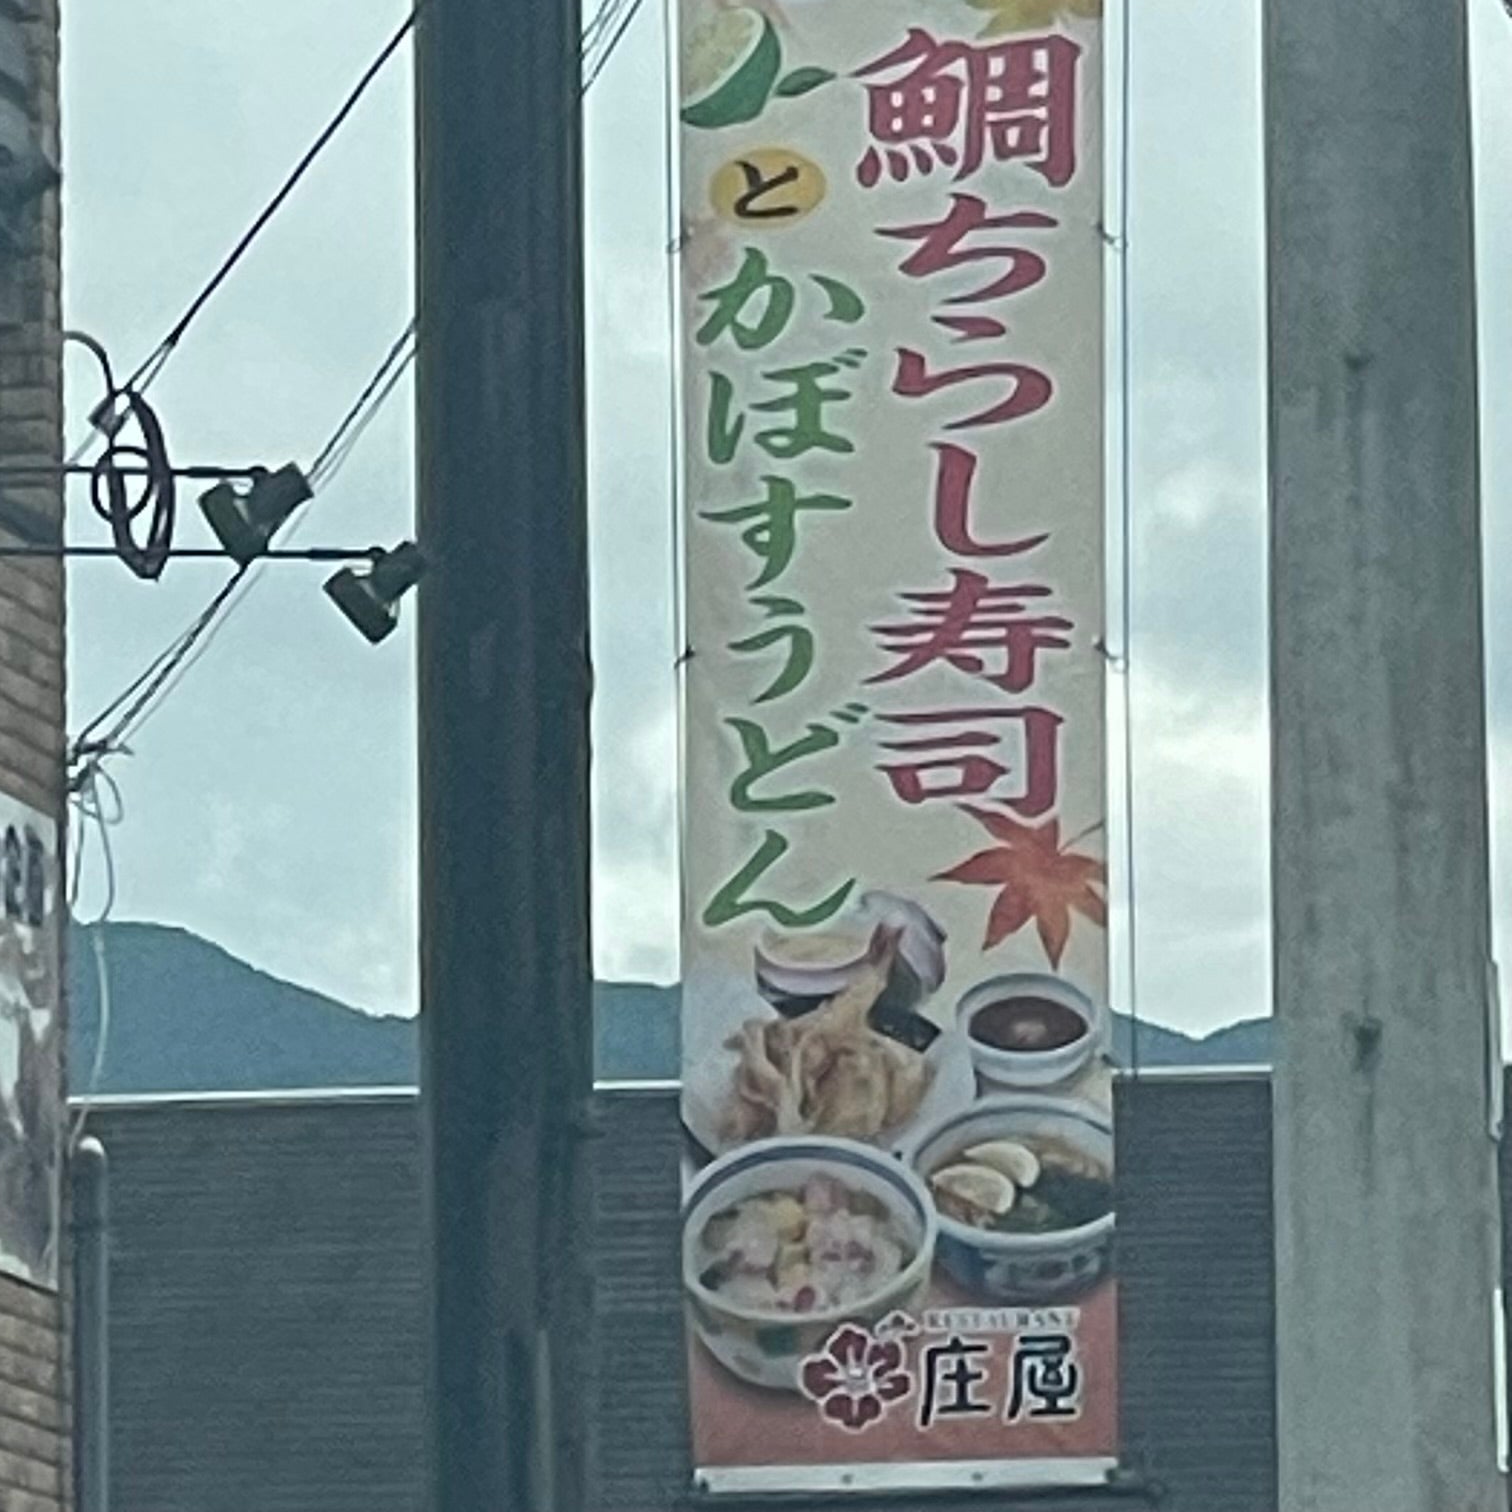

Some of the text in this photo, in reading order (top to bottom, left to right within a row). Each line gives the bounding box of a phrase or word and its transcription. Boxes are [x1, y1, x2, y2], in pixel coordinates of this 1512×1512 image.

[695, 245, 870, 927] かぼすうどん
[847, 27, 1083, 819] 鯛ちらし寿司
[920, 1335, 1079, 1427] 庄屋
